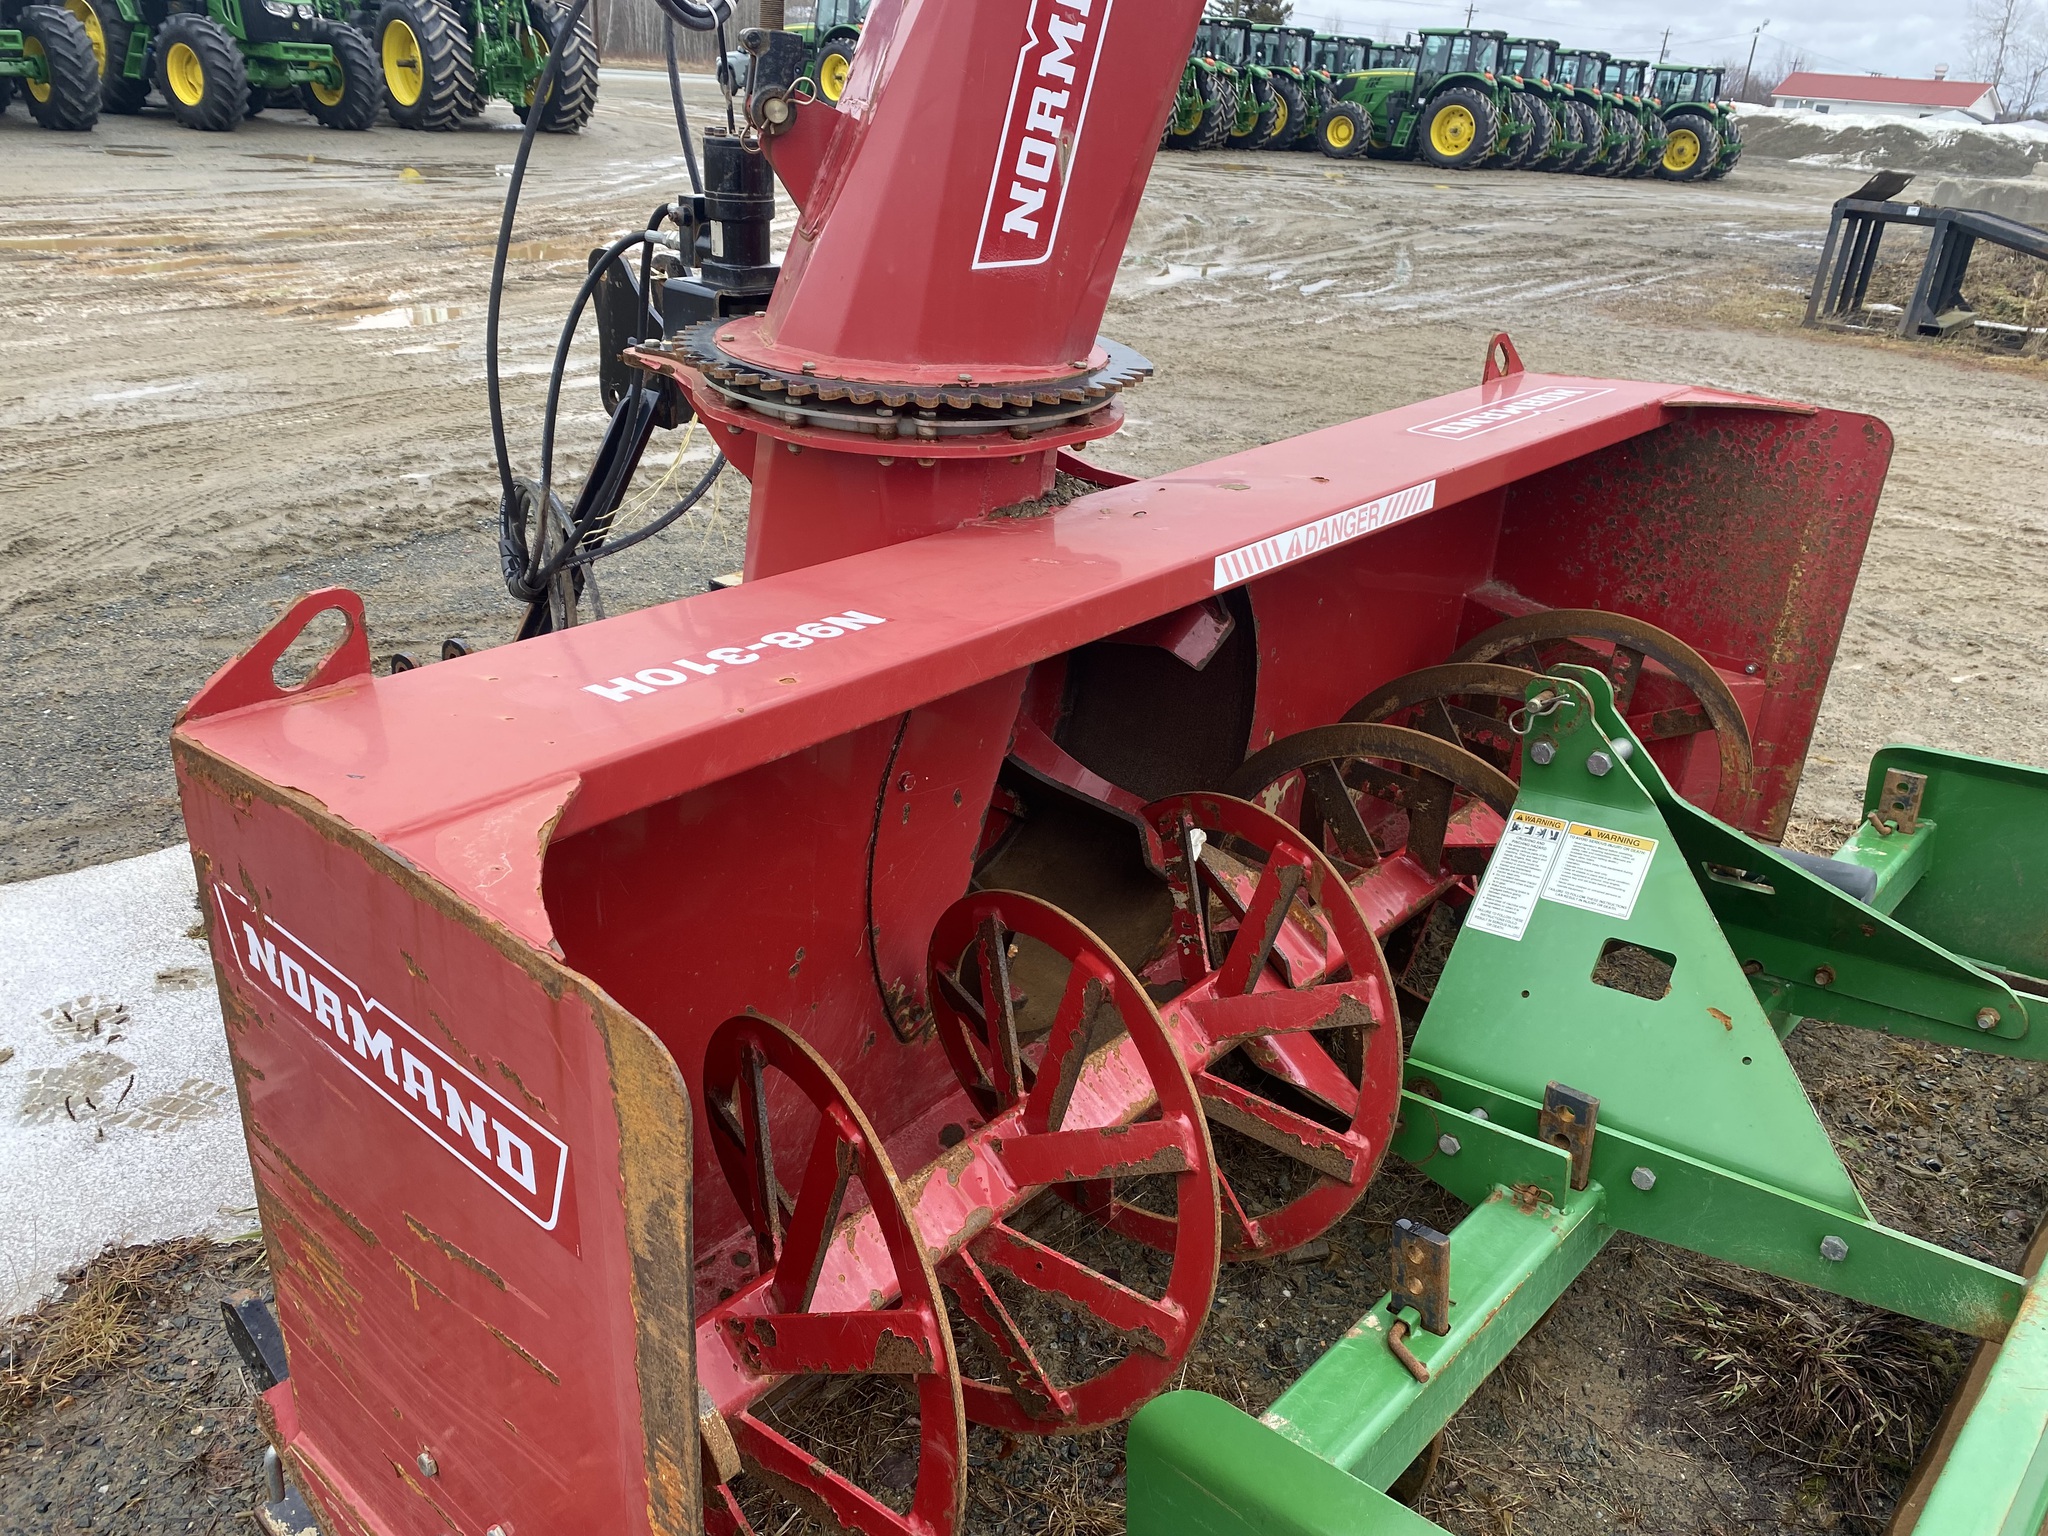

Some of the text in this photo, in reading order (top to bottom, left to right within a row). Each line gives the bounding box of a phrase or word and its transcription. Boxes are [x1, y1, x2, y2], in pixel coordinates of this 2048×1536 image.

[1002, 0, 1092, 239] NORM
[1428, 389, 1586, 434] NORMAND
[1305, 502, 1380, 552] DANGER
[584, 610, 886, 702] N98-310H
[1524, 815, 1562, 830] WARNING
[1596, 831, 1640, 847] WARNING
[242, 921, 536, 1195] NORMAND
